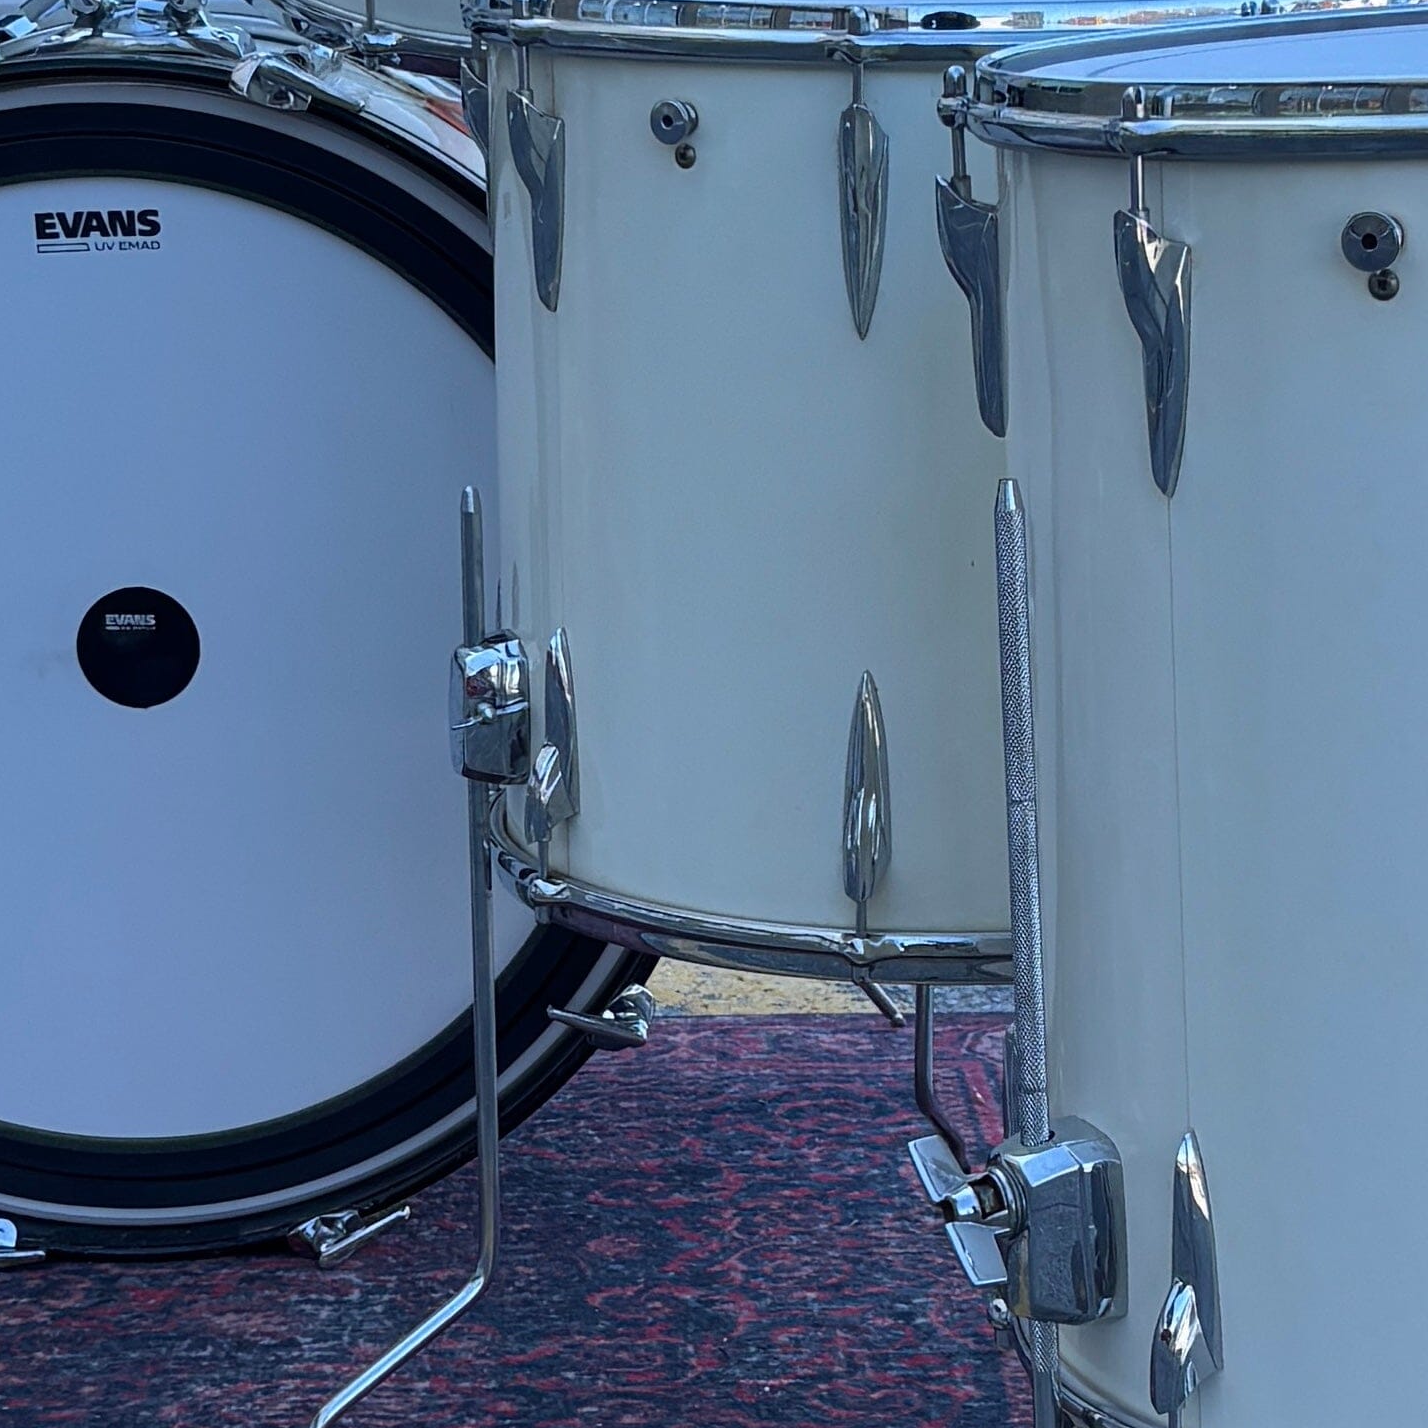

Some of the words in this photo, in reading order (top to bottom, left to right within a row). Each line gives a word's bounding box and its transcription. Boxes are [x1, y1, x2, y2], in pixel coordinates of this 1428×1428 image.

[34, 209, 162, 240] EVANS
[94, 242, 115, 252] UV
[118, 240, 161, 251] EMAD
[105, 614, 156, 626] EVANS
